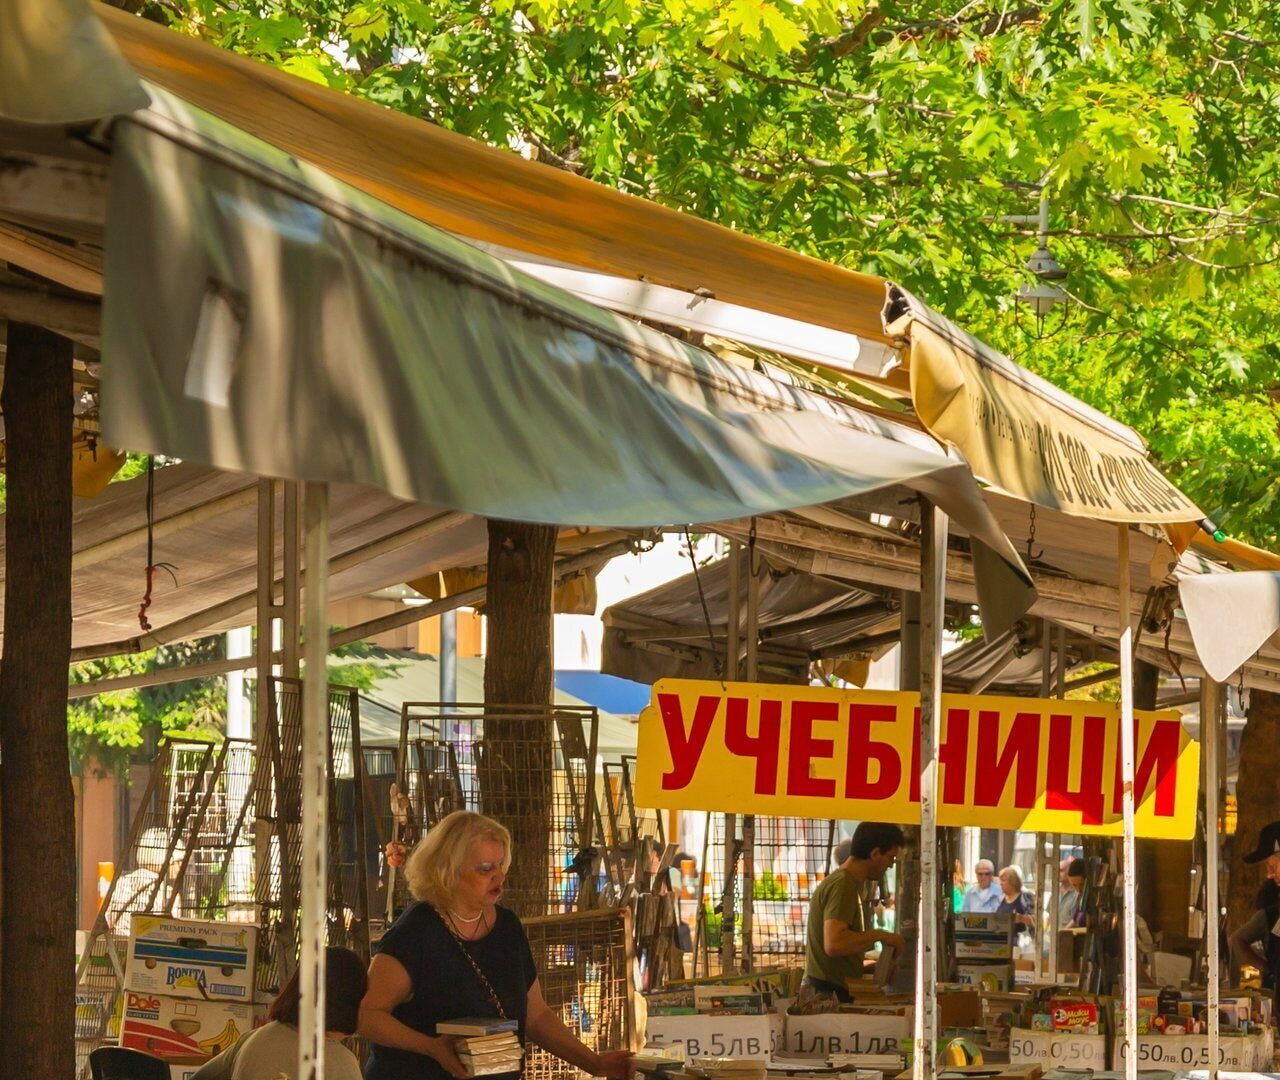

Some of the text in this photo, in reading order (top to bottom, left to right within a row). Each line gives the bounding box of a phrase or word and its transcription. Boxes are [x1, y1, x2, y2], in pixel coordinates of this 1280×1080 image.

[657, 694, 1180, 826] УЧЕБНИЦИ
[166, 966, 207, 989] BONITA
[127, 993, 161, 1010] Dole
